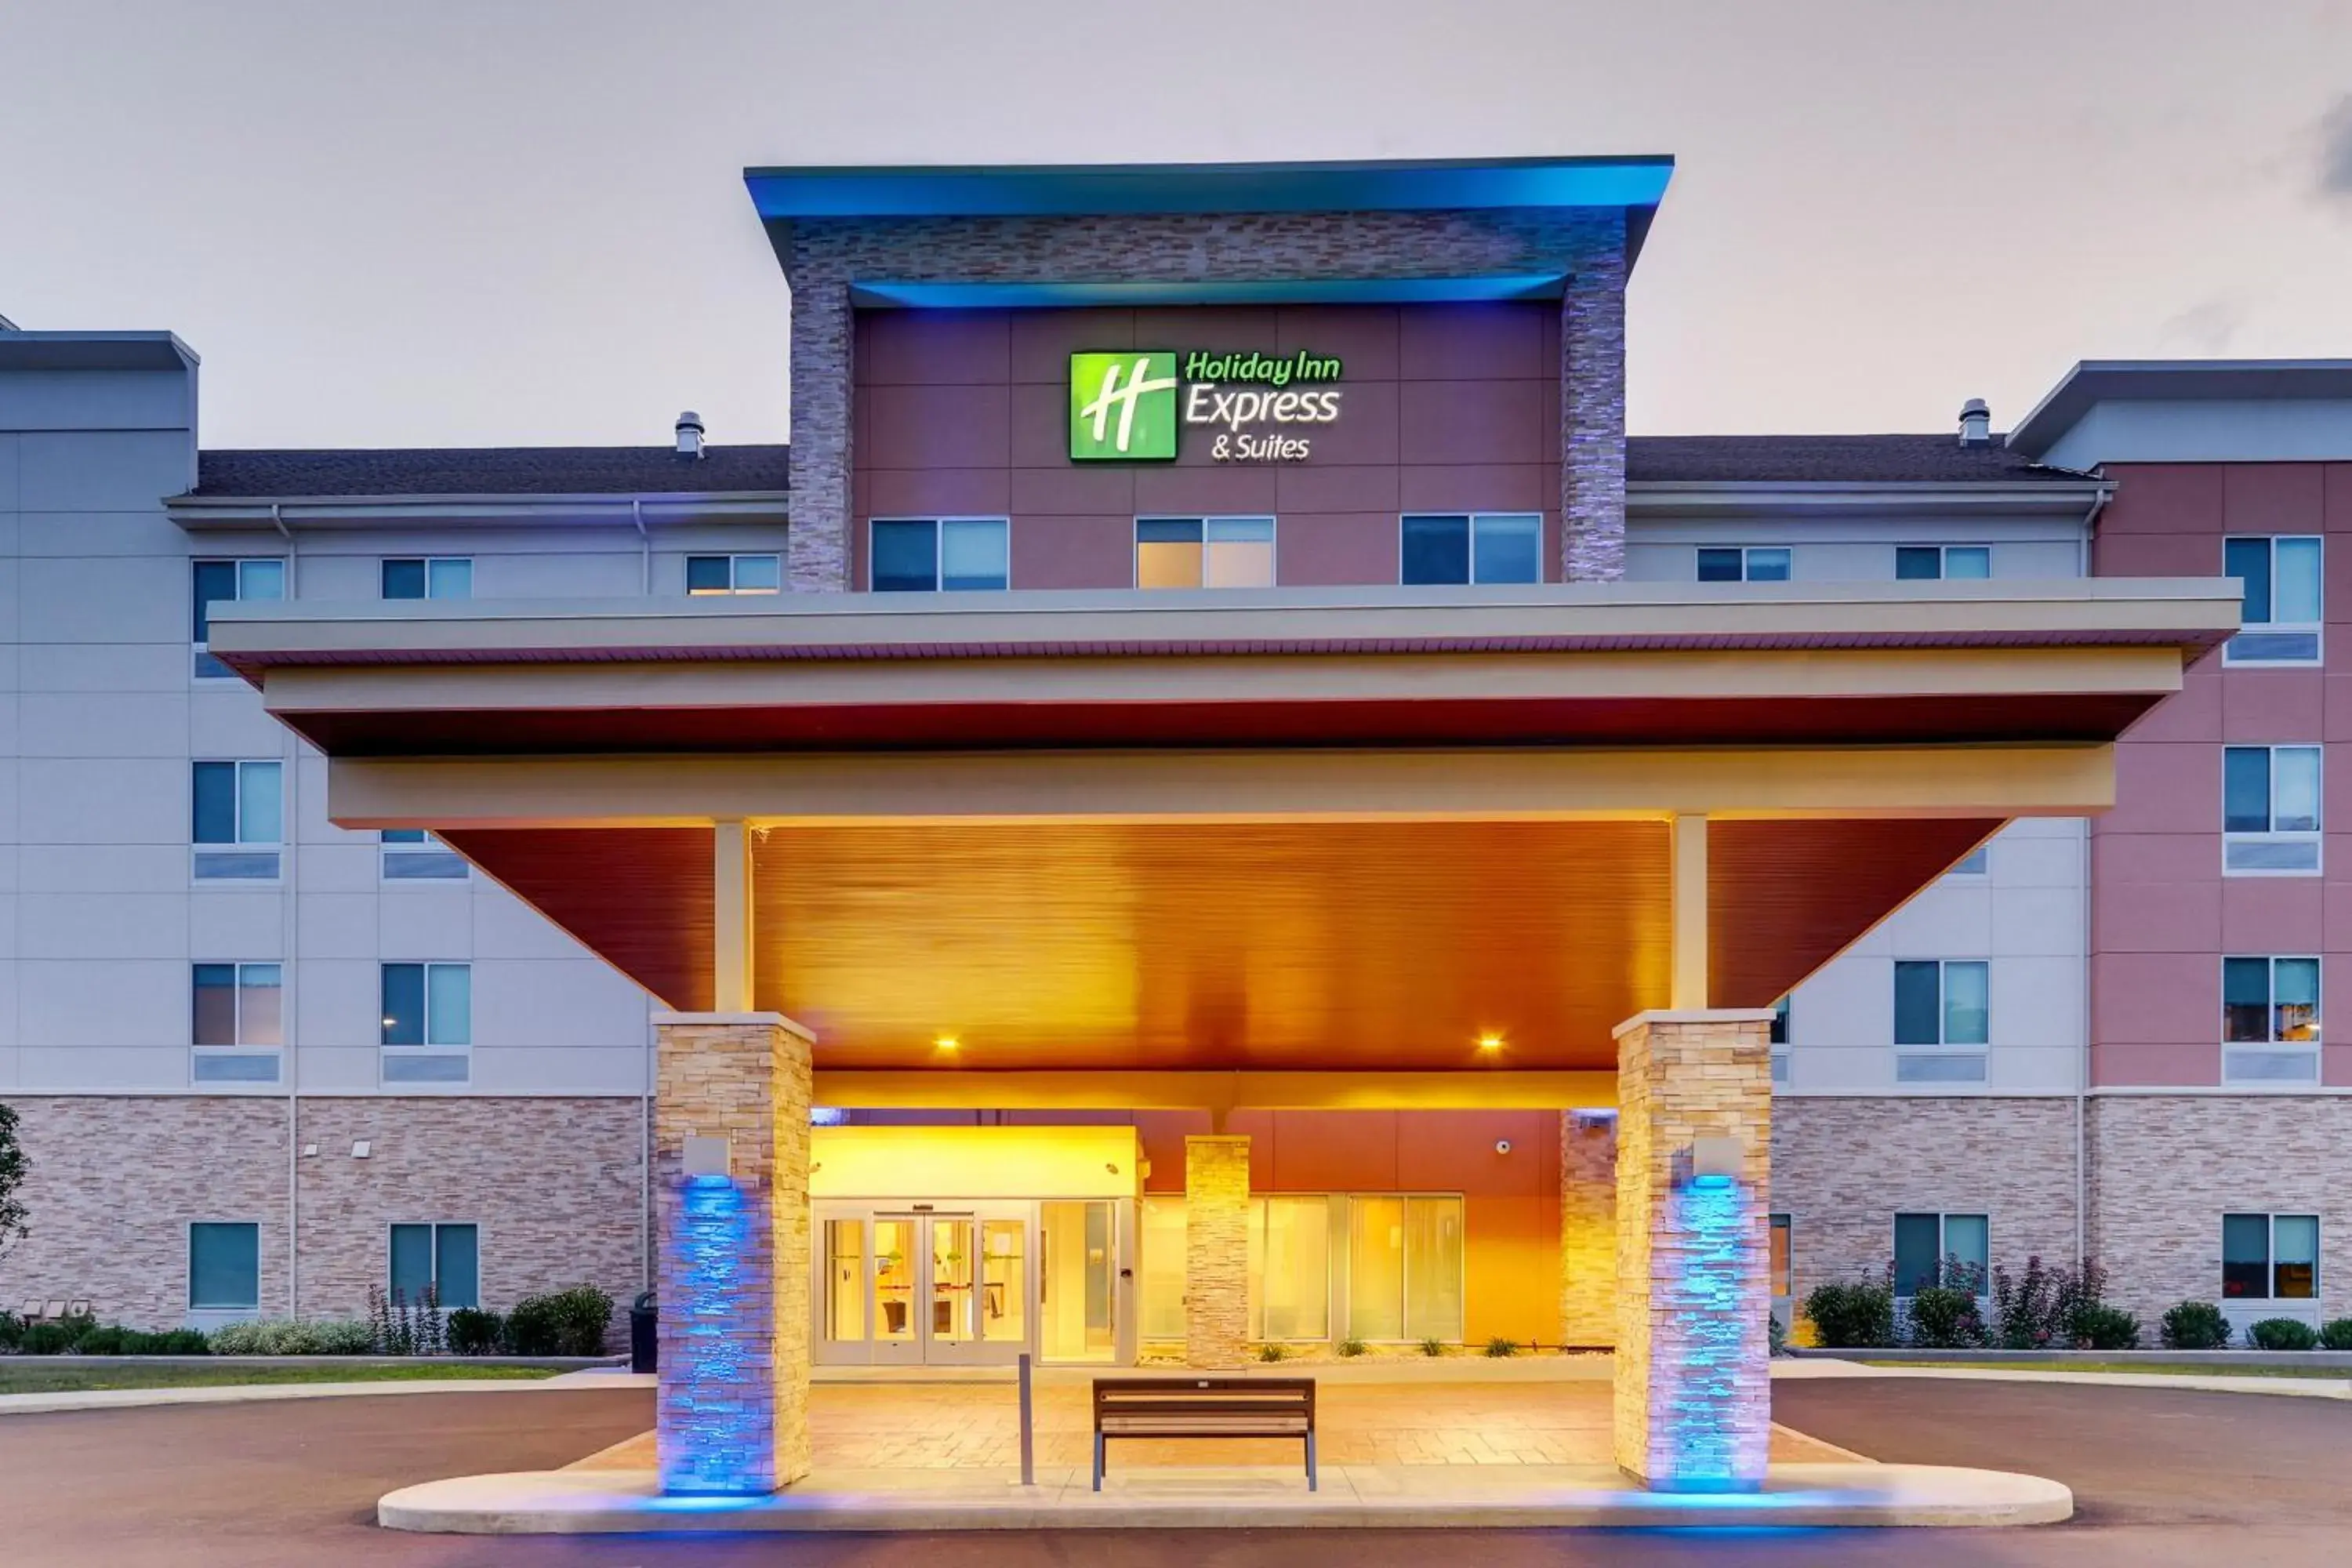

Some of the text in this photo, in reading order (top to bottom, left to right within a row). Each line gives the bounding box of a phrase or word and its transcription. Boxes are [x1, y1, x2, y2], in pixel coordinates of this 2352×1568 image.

[1185, 350, 1340, 385] Holiday Inn
[1186, 383, 1340, 432] Express
[1211, 434, 1309, 460] & Suites
